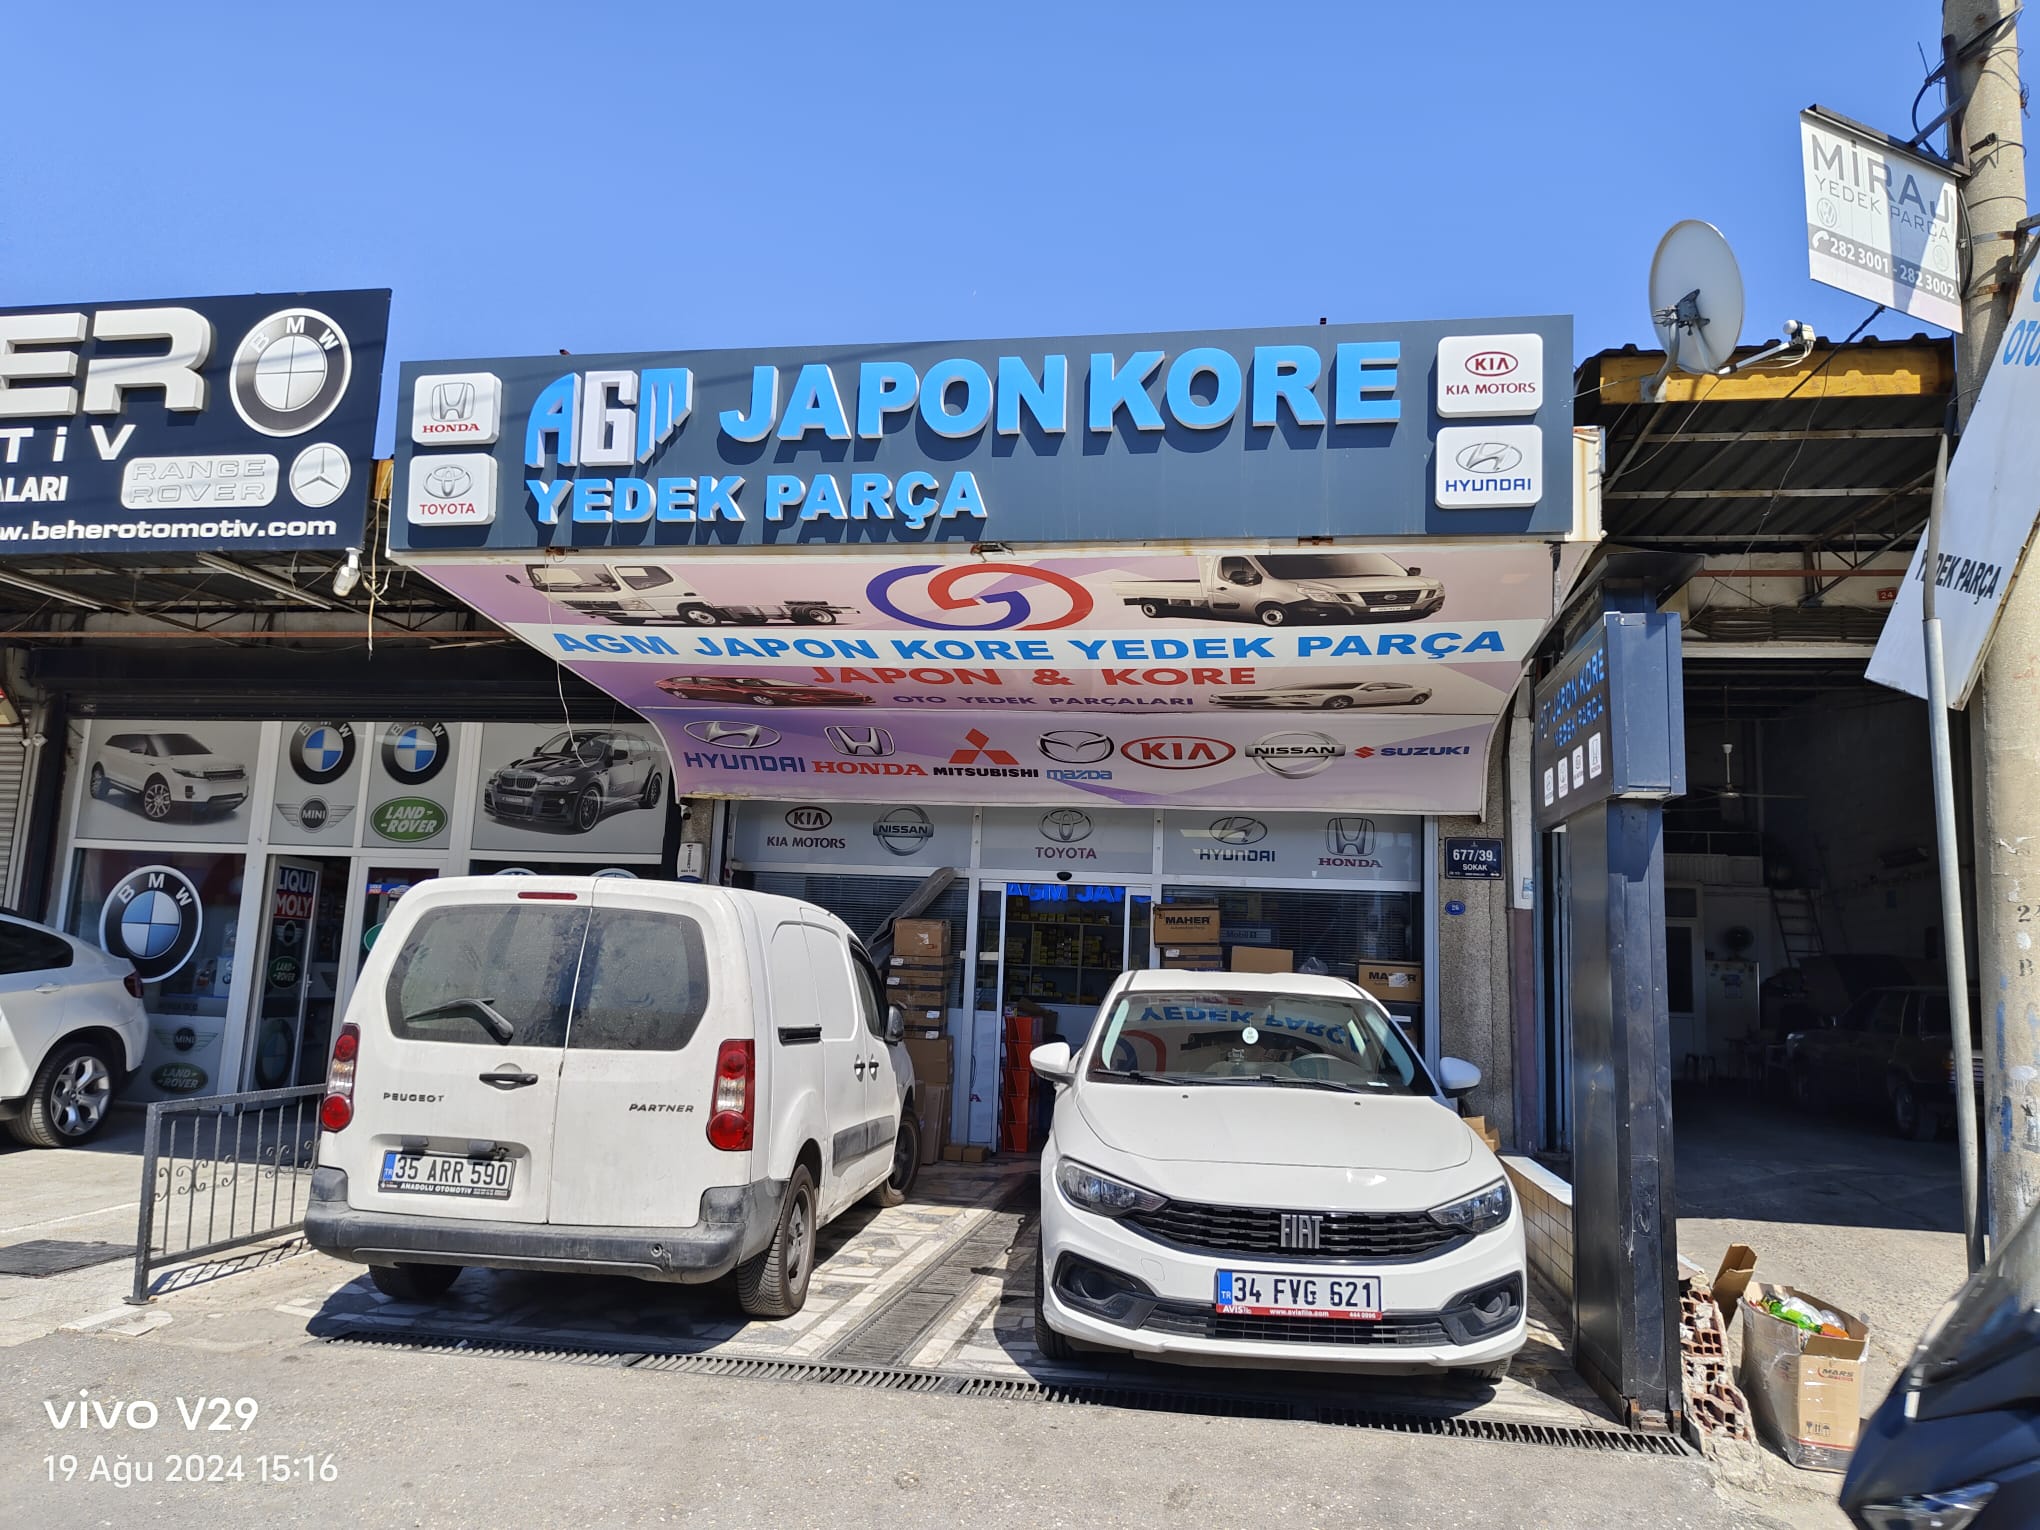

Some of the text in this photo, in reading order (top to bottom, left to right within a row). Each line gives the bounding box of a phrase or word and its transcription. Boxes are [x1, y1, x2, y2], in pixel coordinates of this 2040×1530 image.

[1815, 174, 1882, 215] YEDEK
[1830, 237, 1855, 261] 282
[1858, 245, 1889, 273] 3001
[1900, 264, 1923, 287] 282
[1926, 274, 1955, 299] 3002
[250, 317, 340, 353] BMW
[1474, 357, 1511, 371] KIA
[1445, 381, 1536, 396] KIA MOTORS
[525, 368, 693, 468] AGM
[422, 422, 480, 434] HONDA
[131, 459, 266, 481] RANGE
[128, 481, 266, 504] ROVER
[1445, 478, 1532, 493] HYUNDAI
[525, 471, 987, 529] YEDEK PARÇA
[419, 502, 476, 516] TOYOTA
[1954, 559, 2002, 605] PARÇA
[1880, 591, 1894, 600] 24
[553, 630, 1506, 662] AGM JAPON KORE YEDEK PARÇA
[812, 666, 1257, 687] JAPON & KORE
[1579, 648, 1605, 696] KORE
[892, 695, 1194, 708] OTO YEDEK PARÇALARI
[1138, 741, 1223, 762] KIA
[1253, 743, 1336, 757] NISSAN
[1380, 745, 1471, 757] SUZUKI
[684, 752, 805, 773] HYUNDAI
[812, 760, 928, 776] HONDA
[933, 767, 1039, 778] MITSUBISHI
[302, 810, 326, 820] MINI
[793, 811, 825, 826] KIA
[878, 824, 928, 835] NISSAN
[766, 836, 846, 849] KIA MOTORS
[1035, 846, 1097, 860] TOYOTA
[1199, 848, 1276, 863] HYUNDAI
[1318, 857, 1383, 868] HONDA
[1462, 863, 1488, 871] SOKAK
[279, 869, 315, 893] LIQUI
[117, 873, 193, 907] BMW
[275, 893, 313, 917] MOLY
[1165, 916, 1210, 925] MAHER
[1368, 971, 1417, 982] MAR
[174, 1035, 195, 1043] MINI
[383, 1092, 445, 1103] PEUGEOT
[629, 1103, 695, 1113] PARTNER
[384, 1156, 508, 1187] TR 35 ARR 590
[400, 1182, 434, 1192] ANADOLU
[1280, 1214, 1324, 1250] FIAT
[1221, 1276, 1371, 1308] TR 34 FVG 621
